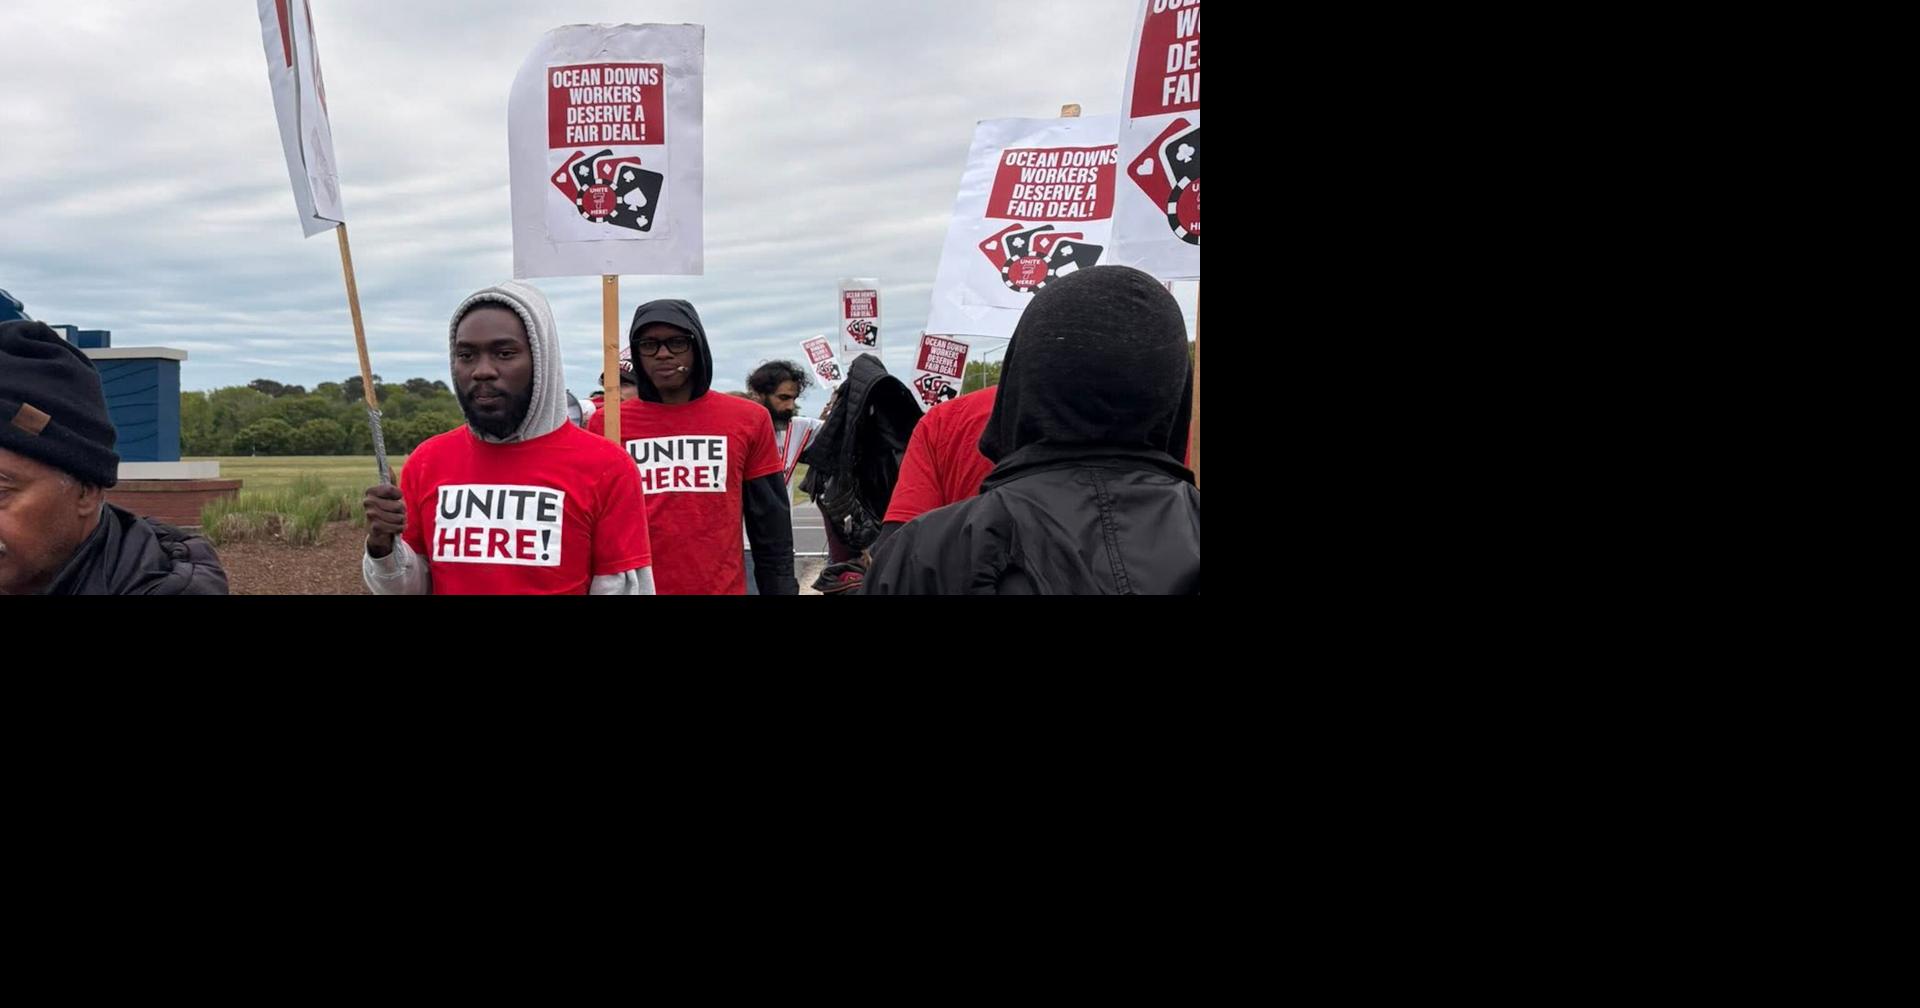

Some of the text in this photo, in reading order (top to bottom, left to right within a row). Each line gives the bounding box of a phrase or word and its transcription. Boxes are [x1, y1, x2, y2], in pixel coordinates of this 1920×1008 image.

[1177, 7, 1200, 39] W
[1166, 40, 1200, 74] DE
[553, 67, 659, 88] OCEAN DOWNS
[569, 86, 642, 104] WORKERS
[567, 105, 645, 124] DESERVE A
[566, 124, 646, 143] FAIR DEAL!
[1005, 148, 1119, 167] OCEAN DOWNS
[1020, 167, 1098, 184] WORKERS
[1012, 184, 1097, 201] DESERVE A
[1006, 201, 1095, 218] FAIR DEAL!
[925, 337, 967, 354] OCEAN DOWNS
[930, 347, 959, 360] WORKERS
[925, 362, 957, 376] FAIR DEAL!
[927, 354, 953, 367] DESERVE
[630, 439, 723, 465] UNITE
[640, 465, 719, 490] HERE!
[440, 489, 559, 522] UNITE
[437, 527, 551, 561] HERE!
